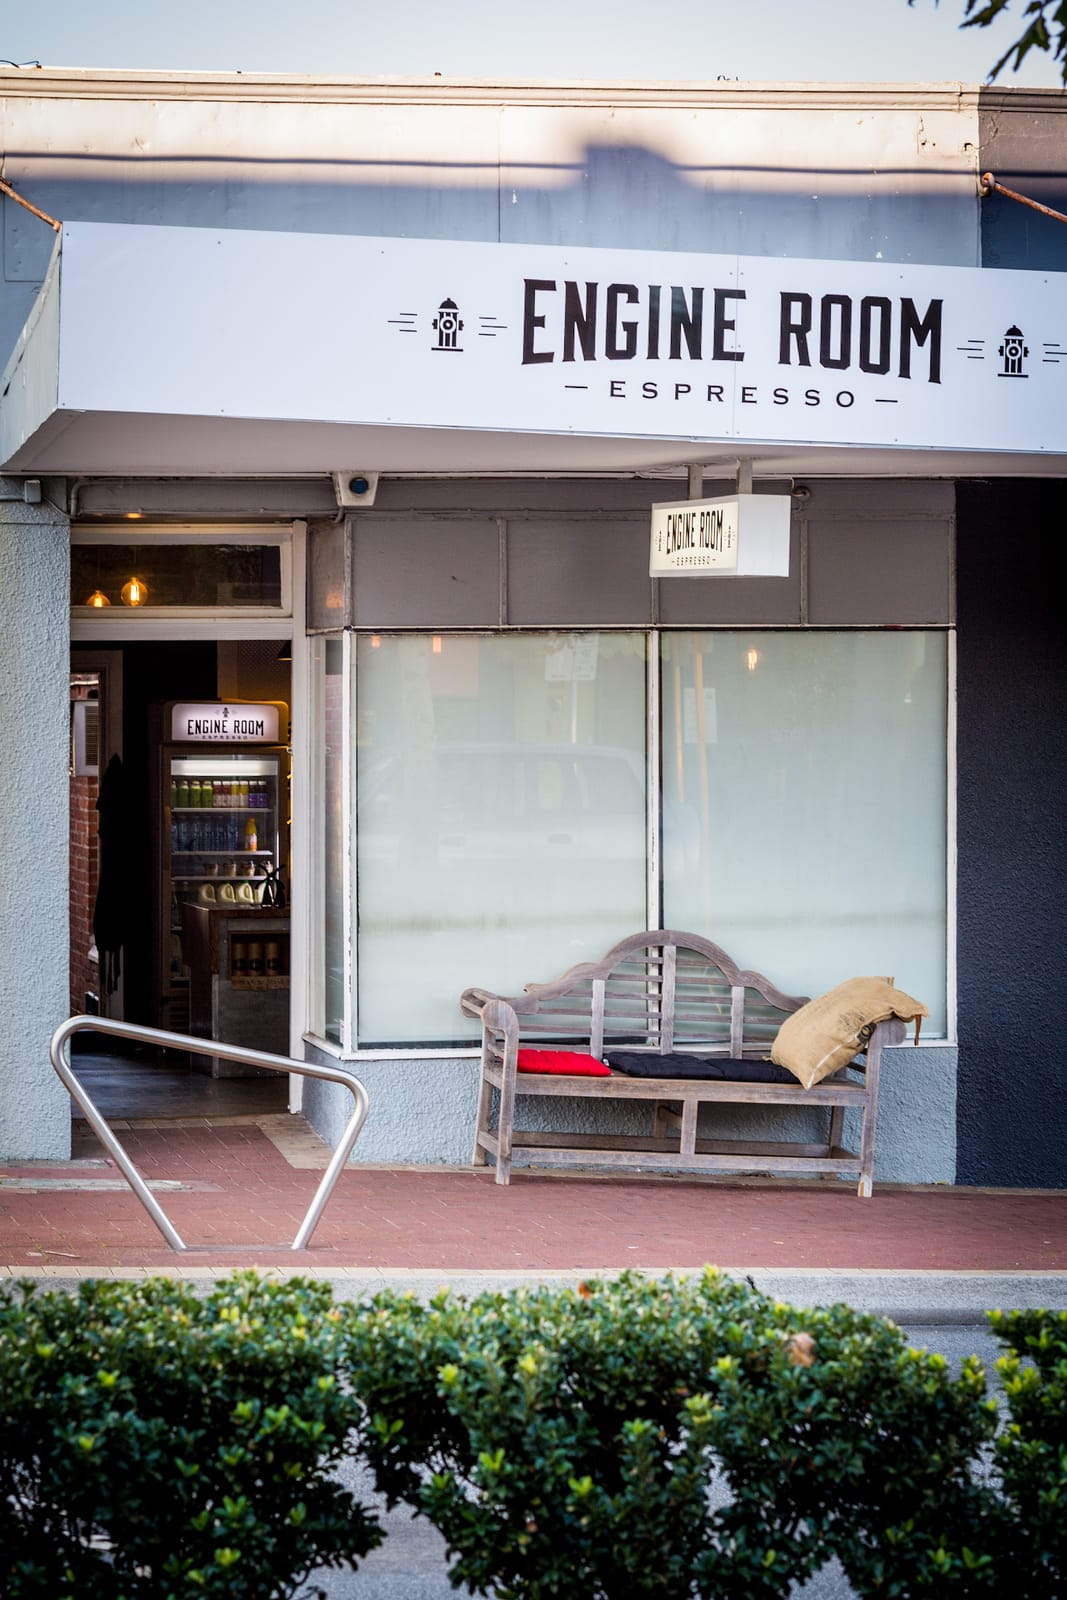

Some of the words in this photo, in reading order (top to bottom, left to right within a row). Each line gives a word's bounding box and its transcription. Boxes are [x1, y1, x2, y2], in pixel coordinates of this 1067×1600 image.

[521, 278, 747, 365] ENGINE
[778, 291, 944, 384] ROOM
[608, 380, 856, 408] ESPRESSO
[666, 512, 696, 555] ENGINE
[699, 509, 724, 553] ROOM
[187, 719, 229, 735] ENGINE
[233, 719, 265, 736] ROOM
